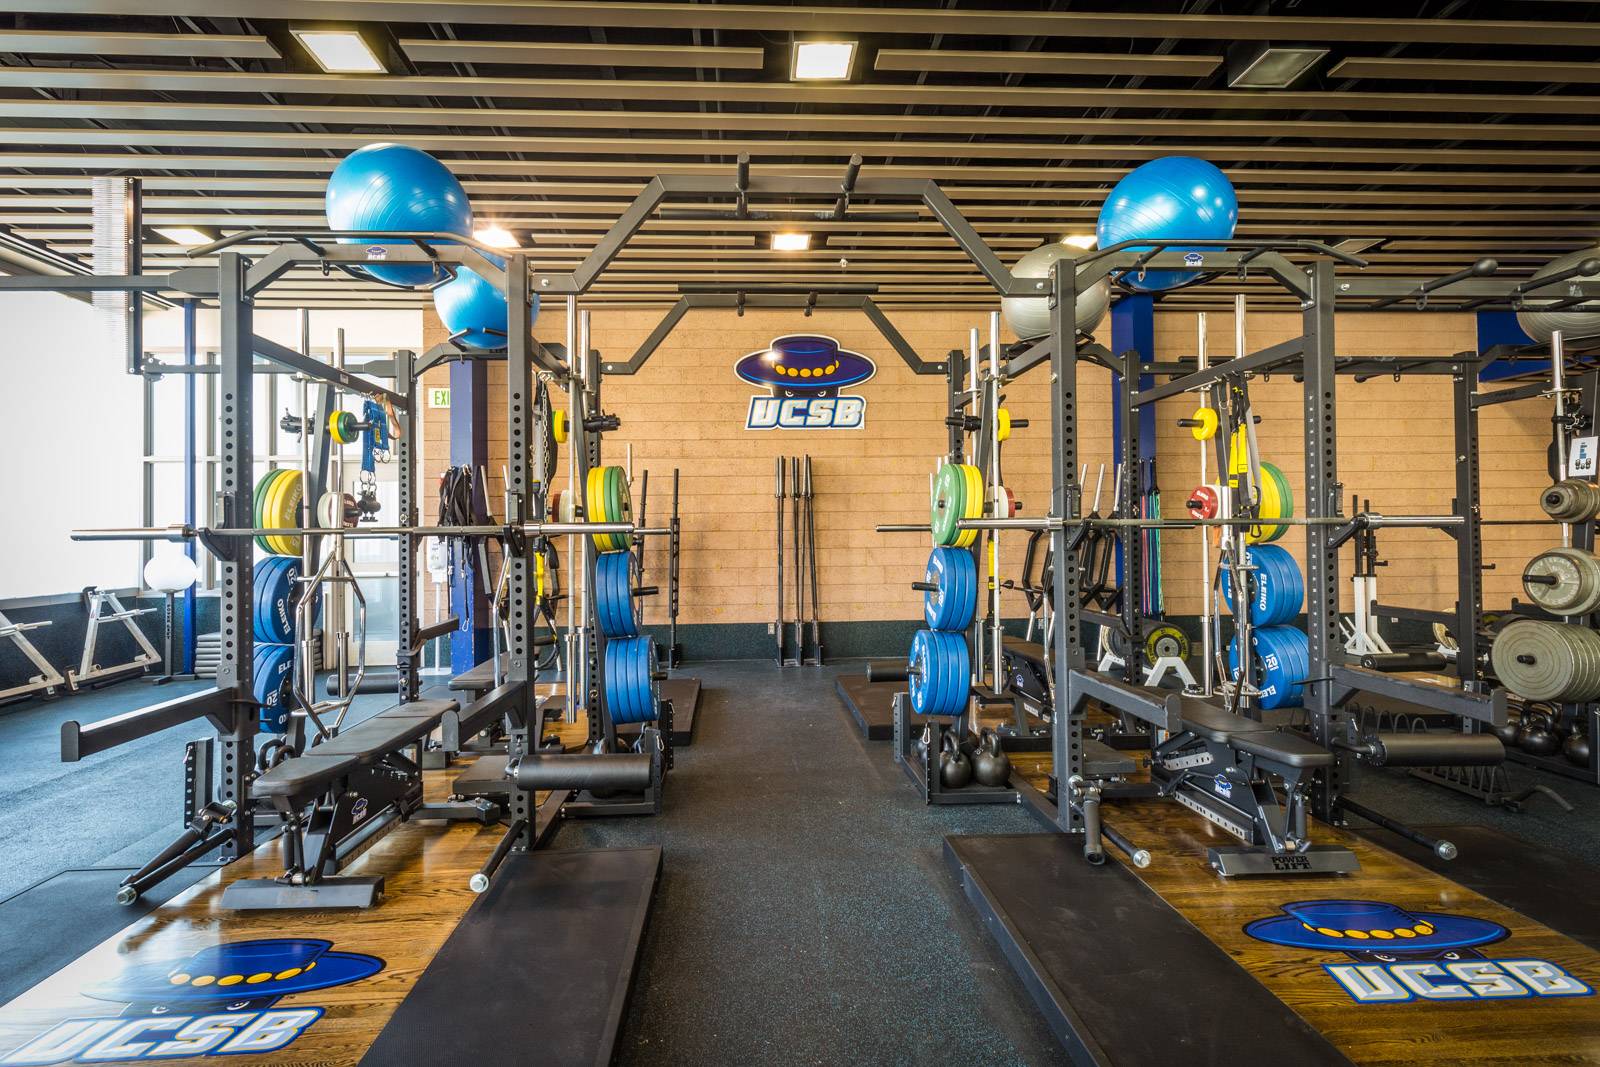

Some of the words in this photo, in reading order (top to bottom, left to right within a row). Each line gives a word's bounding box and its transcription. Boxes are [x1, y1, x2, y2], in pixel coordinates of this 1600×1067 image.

[434, 390, 450, 406] EXI
[746, 396, 865, 429] UCSB
[1260, 573, 1268, 612] ELEIKO
[277, 598, 292, 636] ELEIKO
[278, 660, 292, 675] ELE
[1265, 655, 1279, 669] 20
[1258, 685, 1277, 698] ELE
[1271, 856, 1309, 864] POWER
[1274, 862, 1312, 870] LIFT
[1320, 957, 1596, 1003] UCSB
[0, 1006, 326, 1066] UCSB
